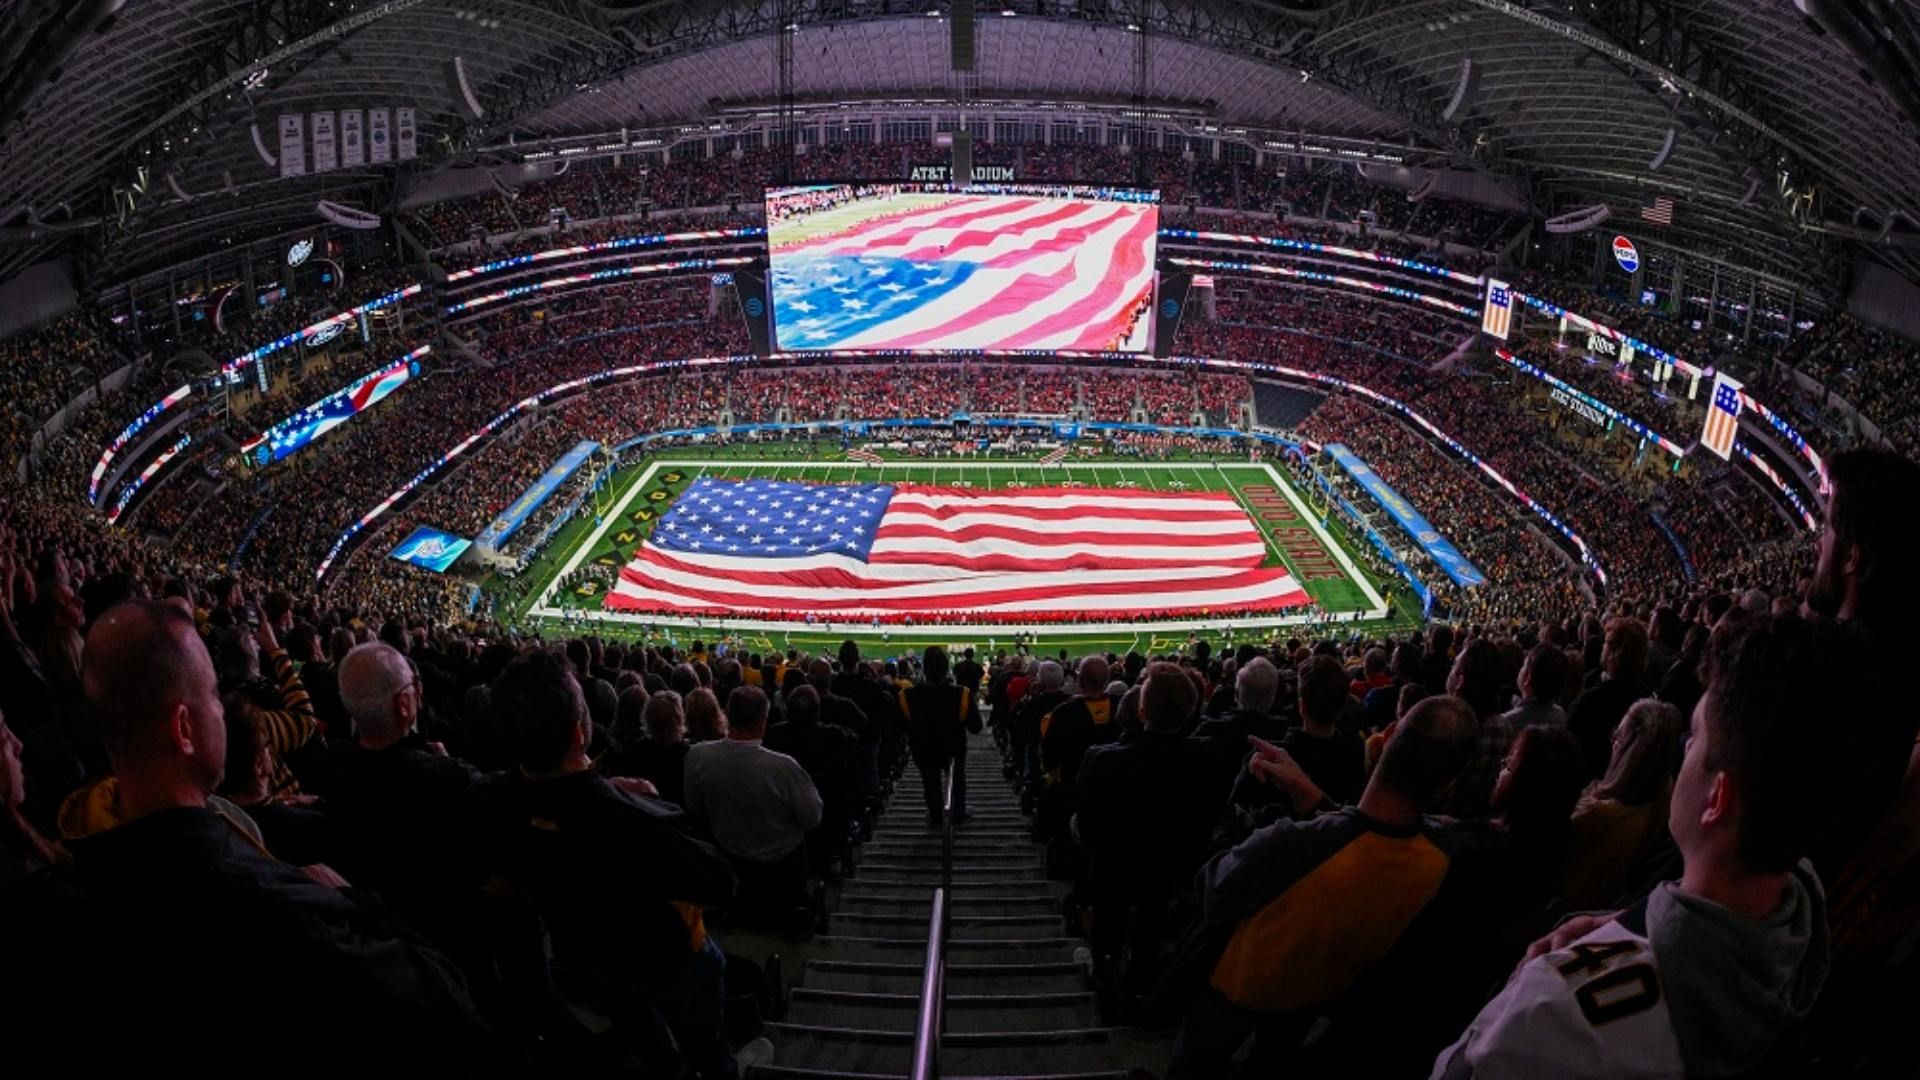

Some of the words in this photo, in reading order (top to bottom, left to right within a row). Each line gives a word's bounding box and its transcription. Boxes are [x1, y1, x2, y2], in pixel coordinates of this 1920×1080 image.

[911, 166, 947, 181] AT&T
[1570, 397, 1606, 427] STADIUM
[1239, 485, 1299, 521] OHIO
[1273, 527, 1347, 582] STATE
[1556, 939, 1662, 1027] 40
